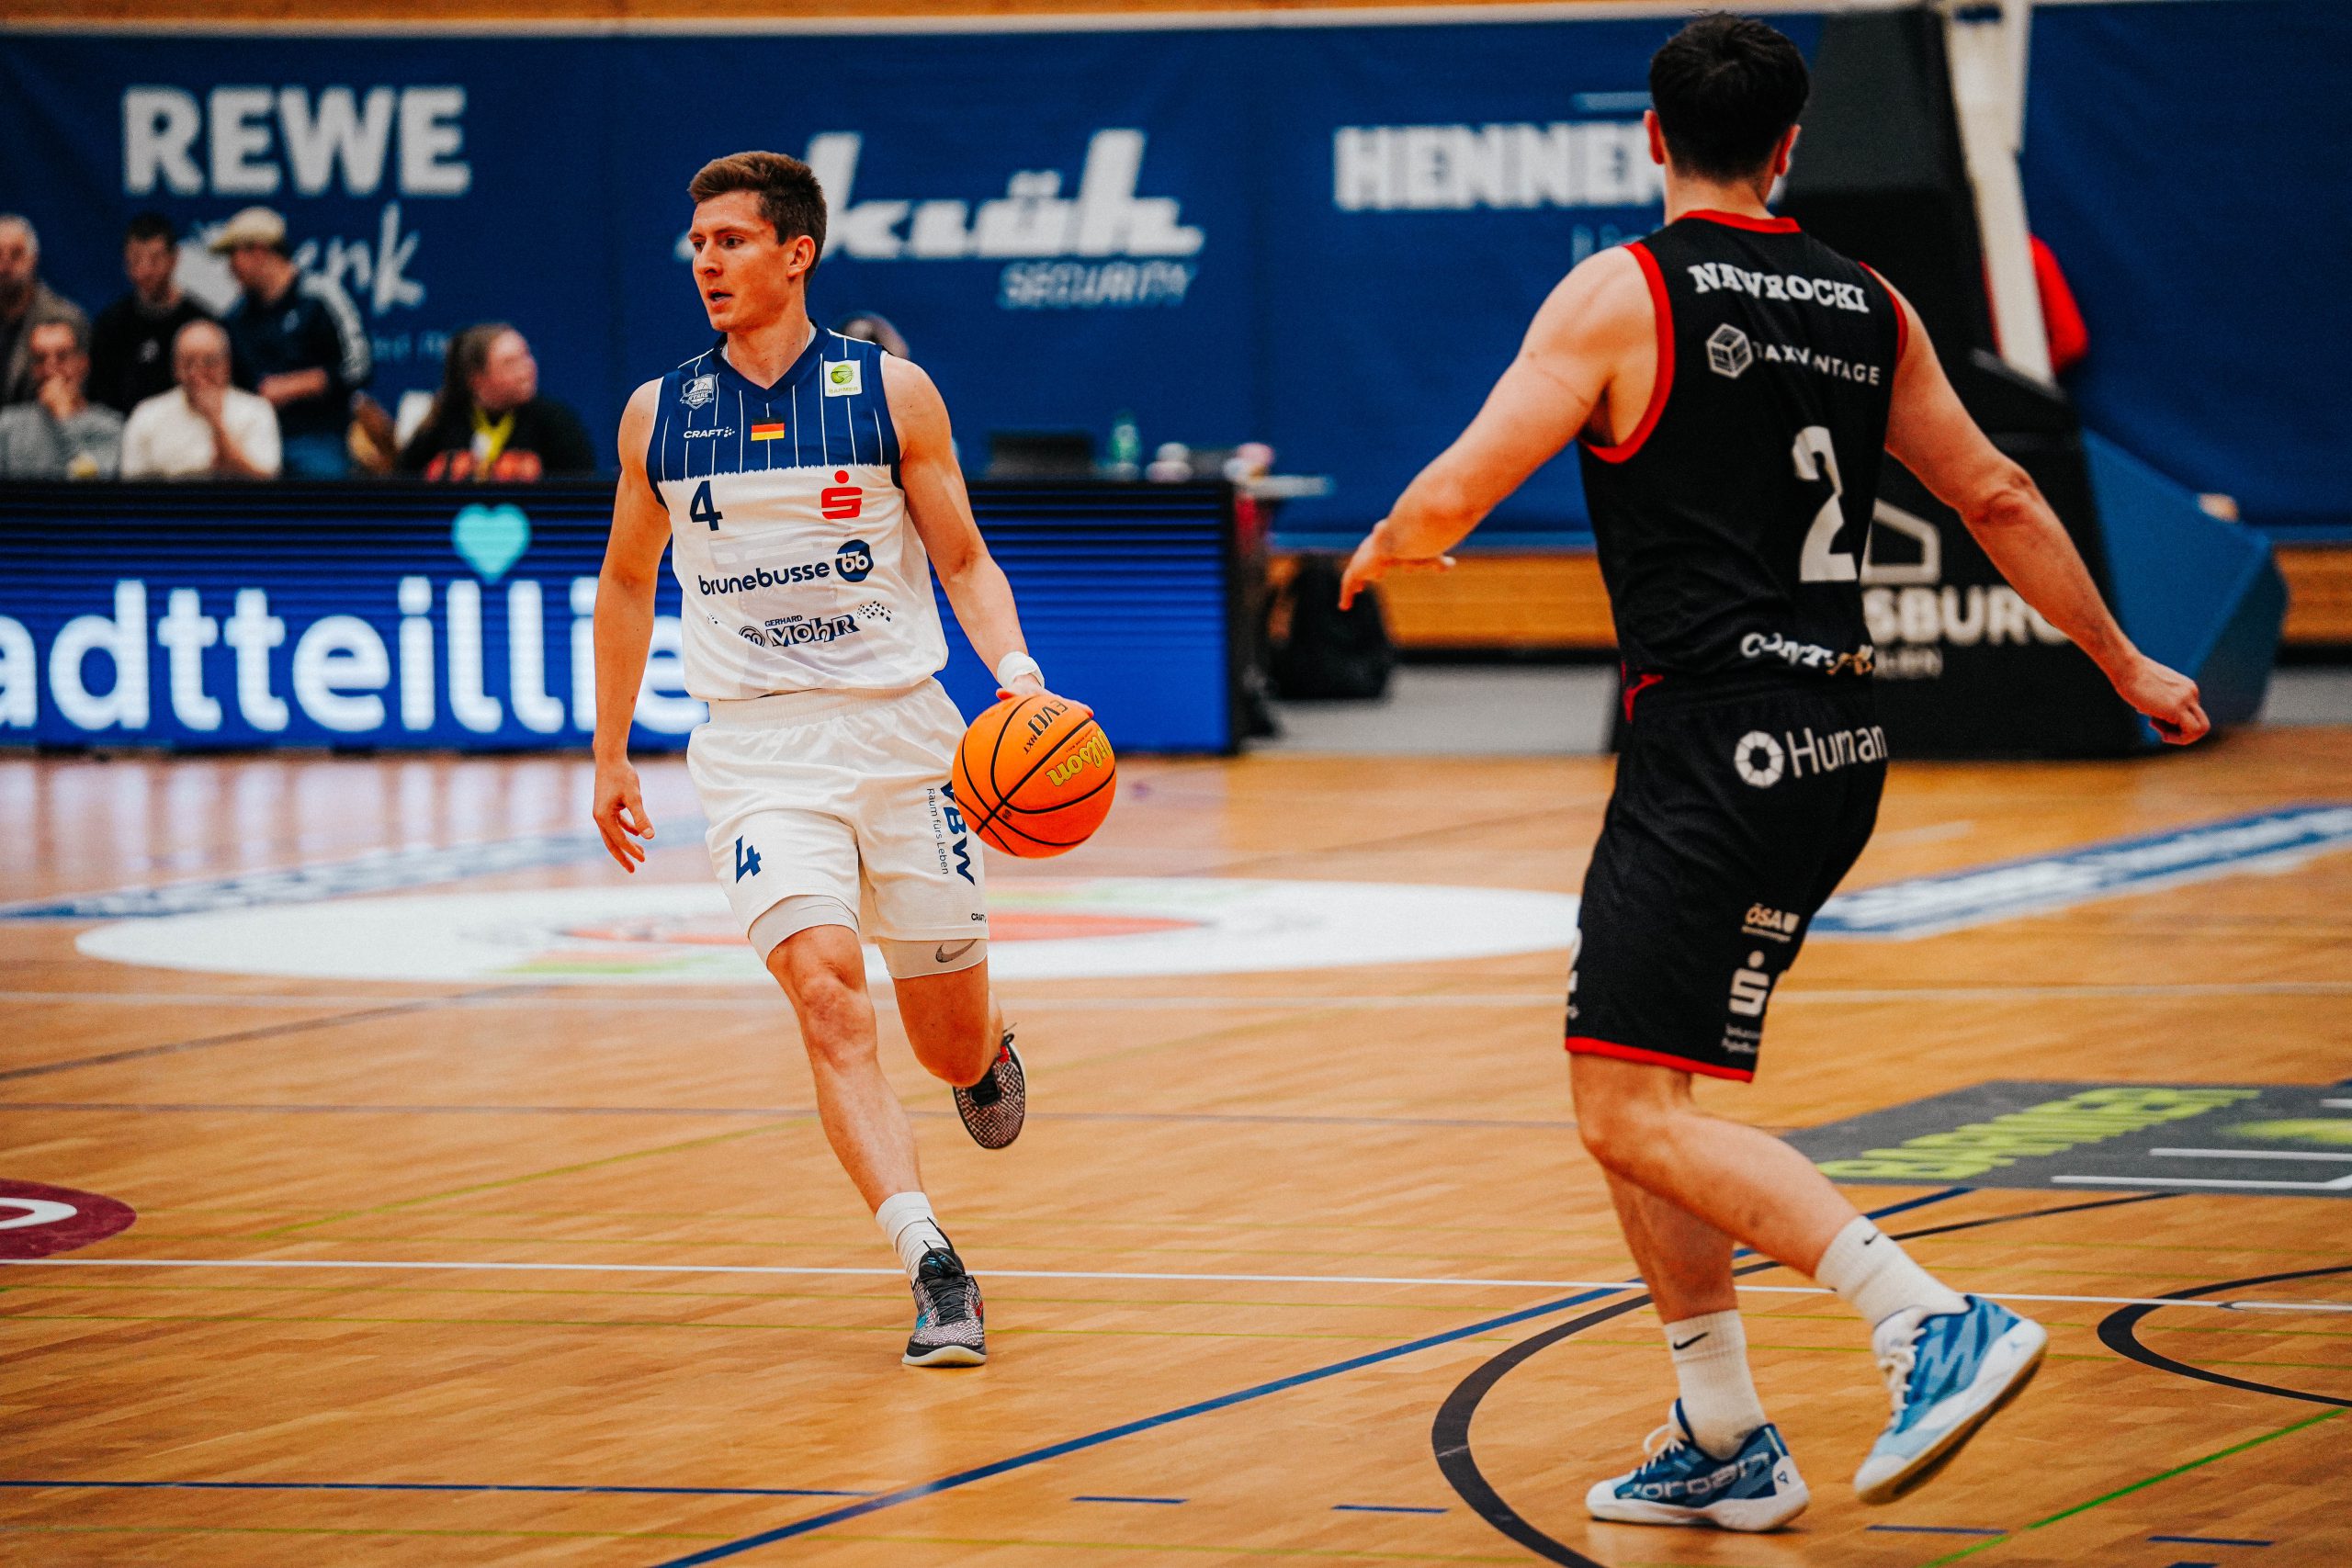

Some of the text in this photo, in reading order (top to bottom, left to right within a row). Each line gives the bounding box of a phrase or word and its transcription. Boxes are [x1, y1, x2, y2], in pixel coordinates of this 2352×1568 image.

[122, 85, 470, 195] REWE
[1334, 120, 1667, 212] HENNE
[1001, 262, 1192, 307] SECURITY
[684, 429, 724, 438] CRAFT
[690, 480, 723, 531] 4
[1792, 425, 1857, 582] 2
[698, 561, 830, 596] brunebusse
[764, 615, 803, 627] GERHARD
[1023, 734, 1037, 755] NXT
[1786, 725, 1888, 778] Human
[927, 788, 948, 874] Raum fürs Leben
[736, 835, 762, 884] 4
